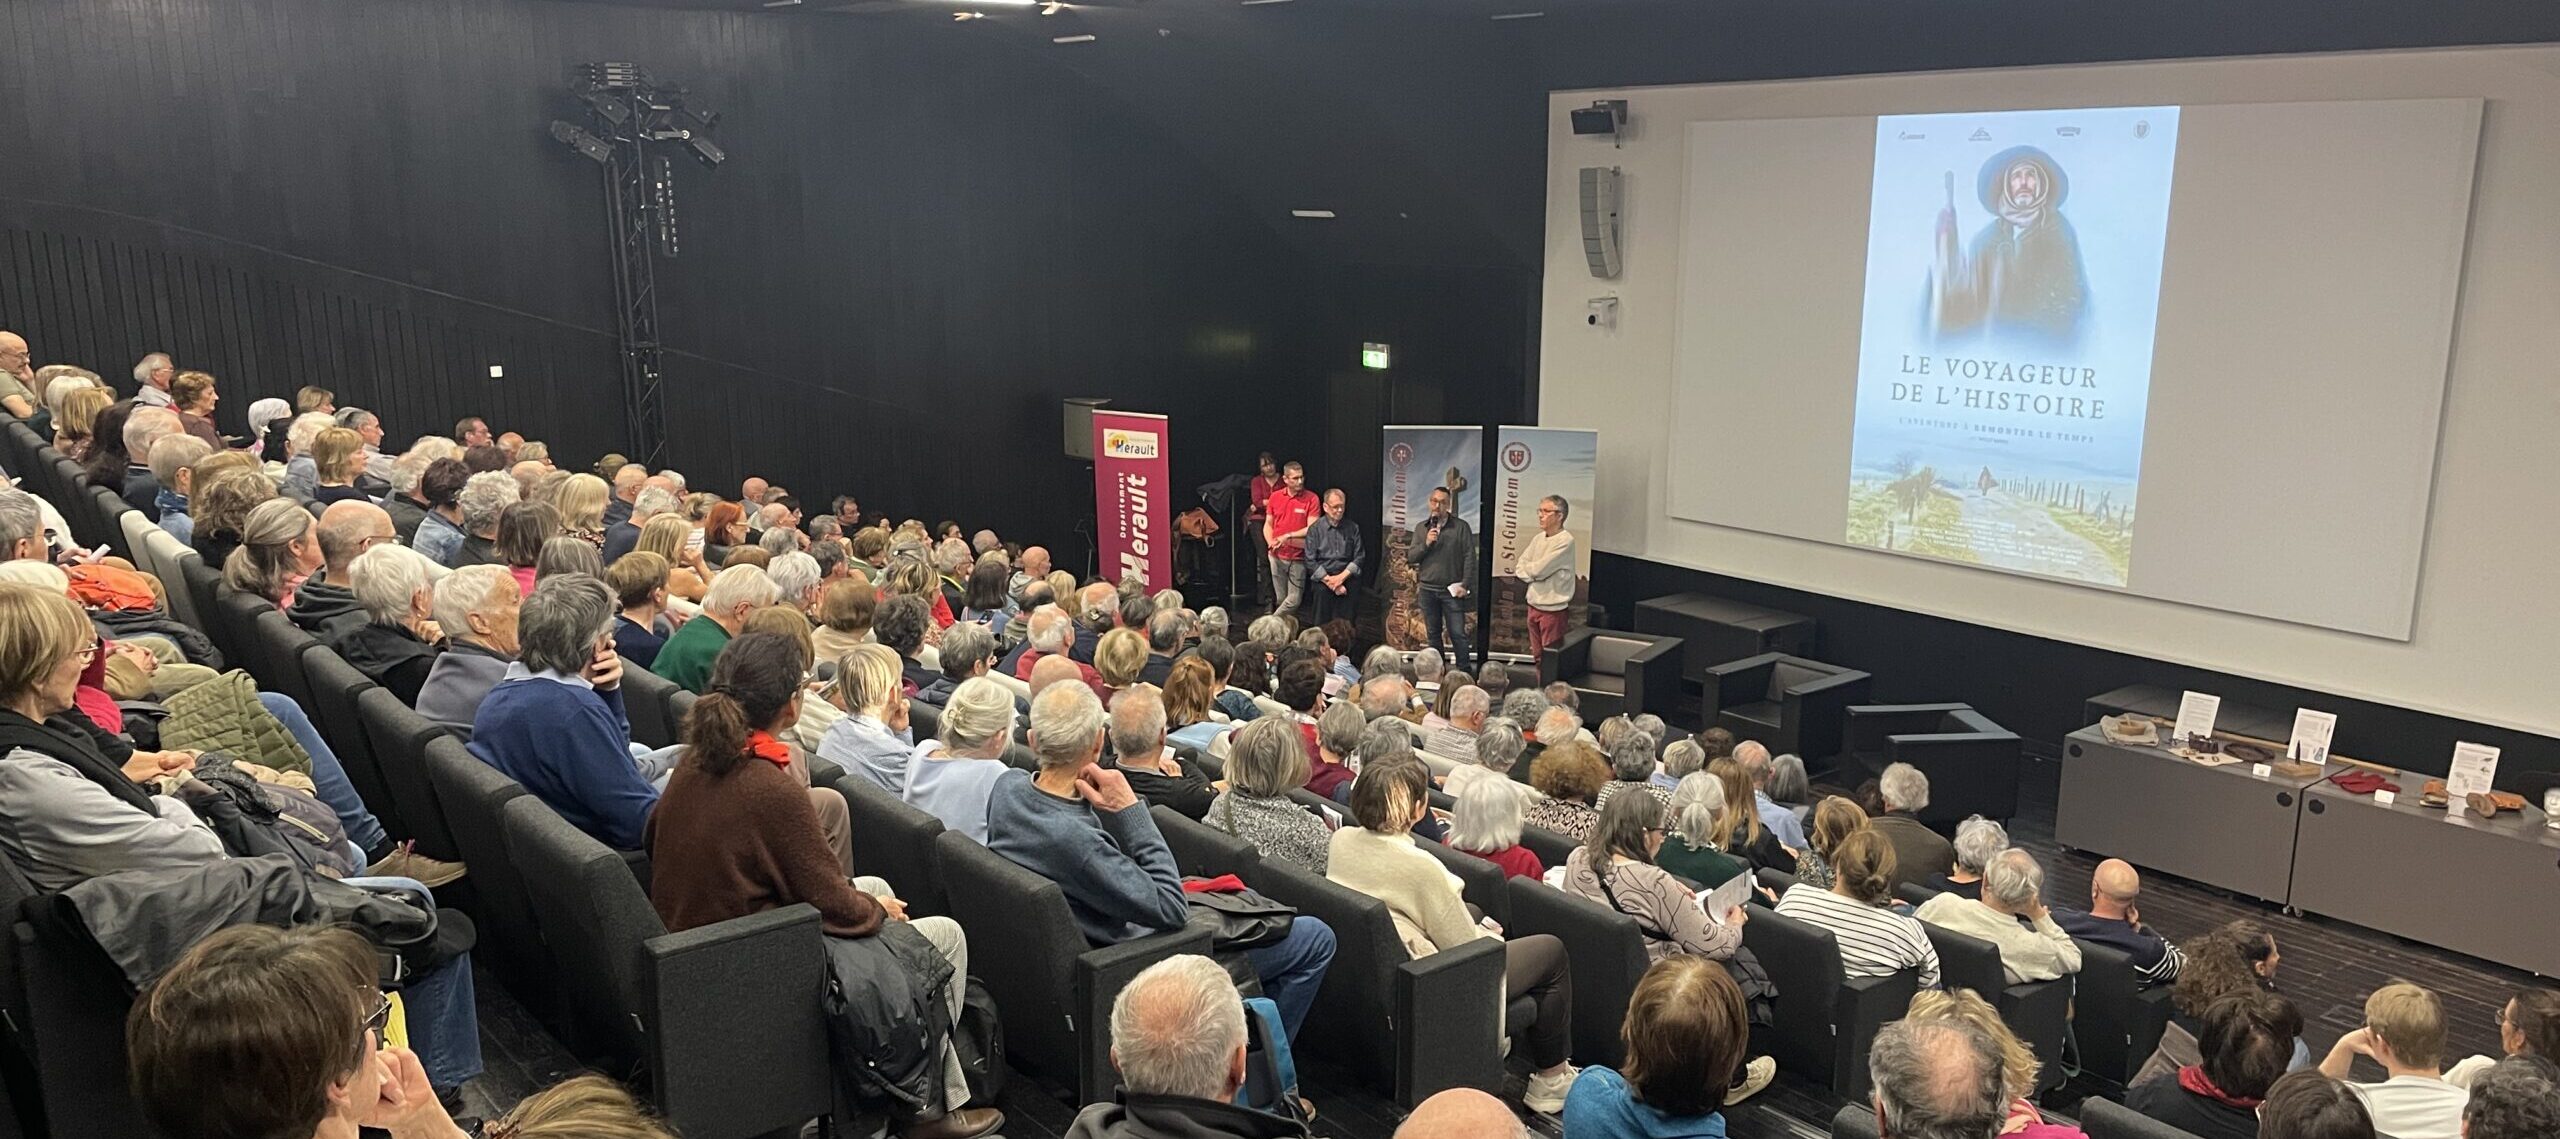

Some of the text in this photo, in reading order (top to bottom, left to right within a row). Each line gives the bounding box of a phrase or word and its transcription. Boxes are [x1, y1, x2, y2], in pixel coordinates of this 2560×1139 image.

[1901, 355, 2097, 389] LE VOYAGEUR
[1890, 382, 2105, 420] DE L'HISTOIRE
[1500, 477, 1519, 561] St-Guilhem
